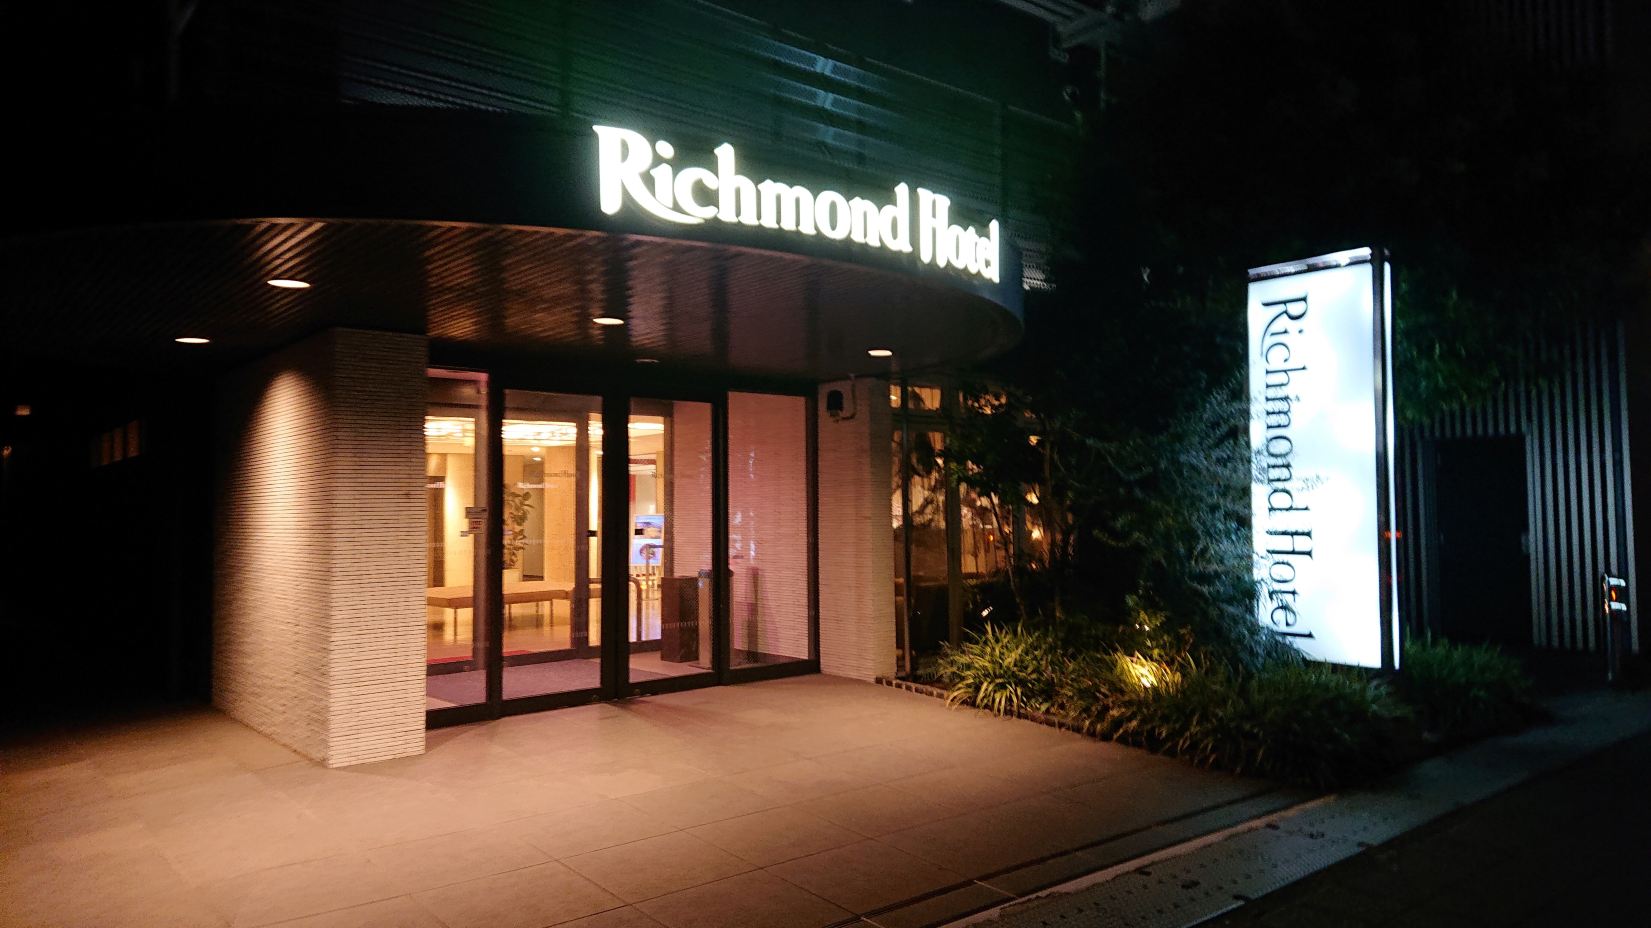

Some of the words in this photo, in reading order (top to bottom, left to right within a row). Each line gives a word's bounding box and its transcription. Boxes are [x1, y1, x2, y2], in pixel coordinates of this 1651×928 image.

[592, 124, 913, 254] Richmond
[917, 187, 1000, 284] Hotel
[1261, 293, 1310, 518] Richmond
[1265, 528, 1316, 641] Hotel
